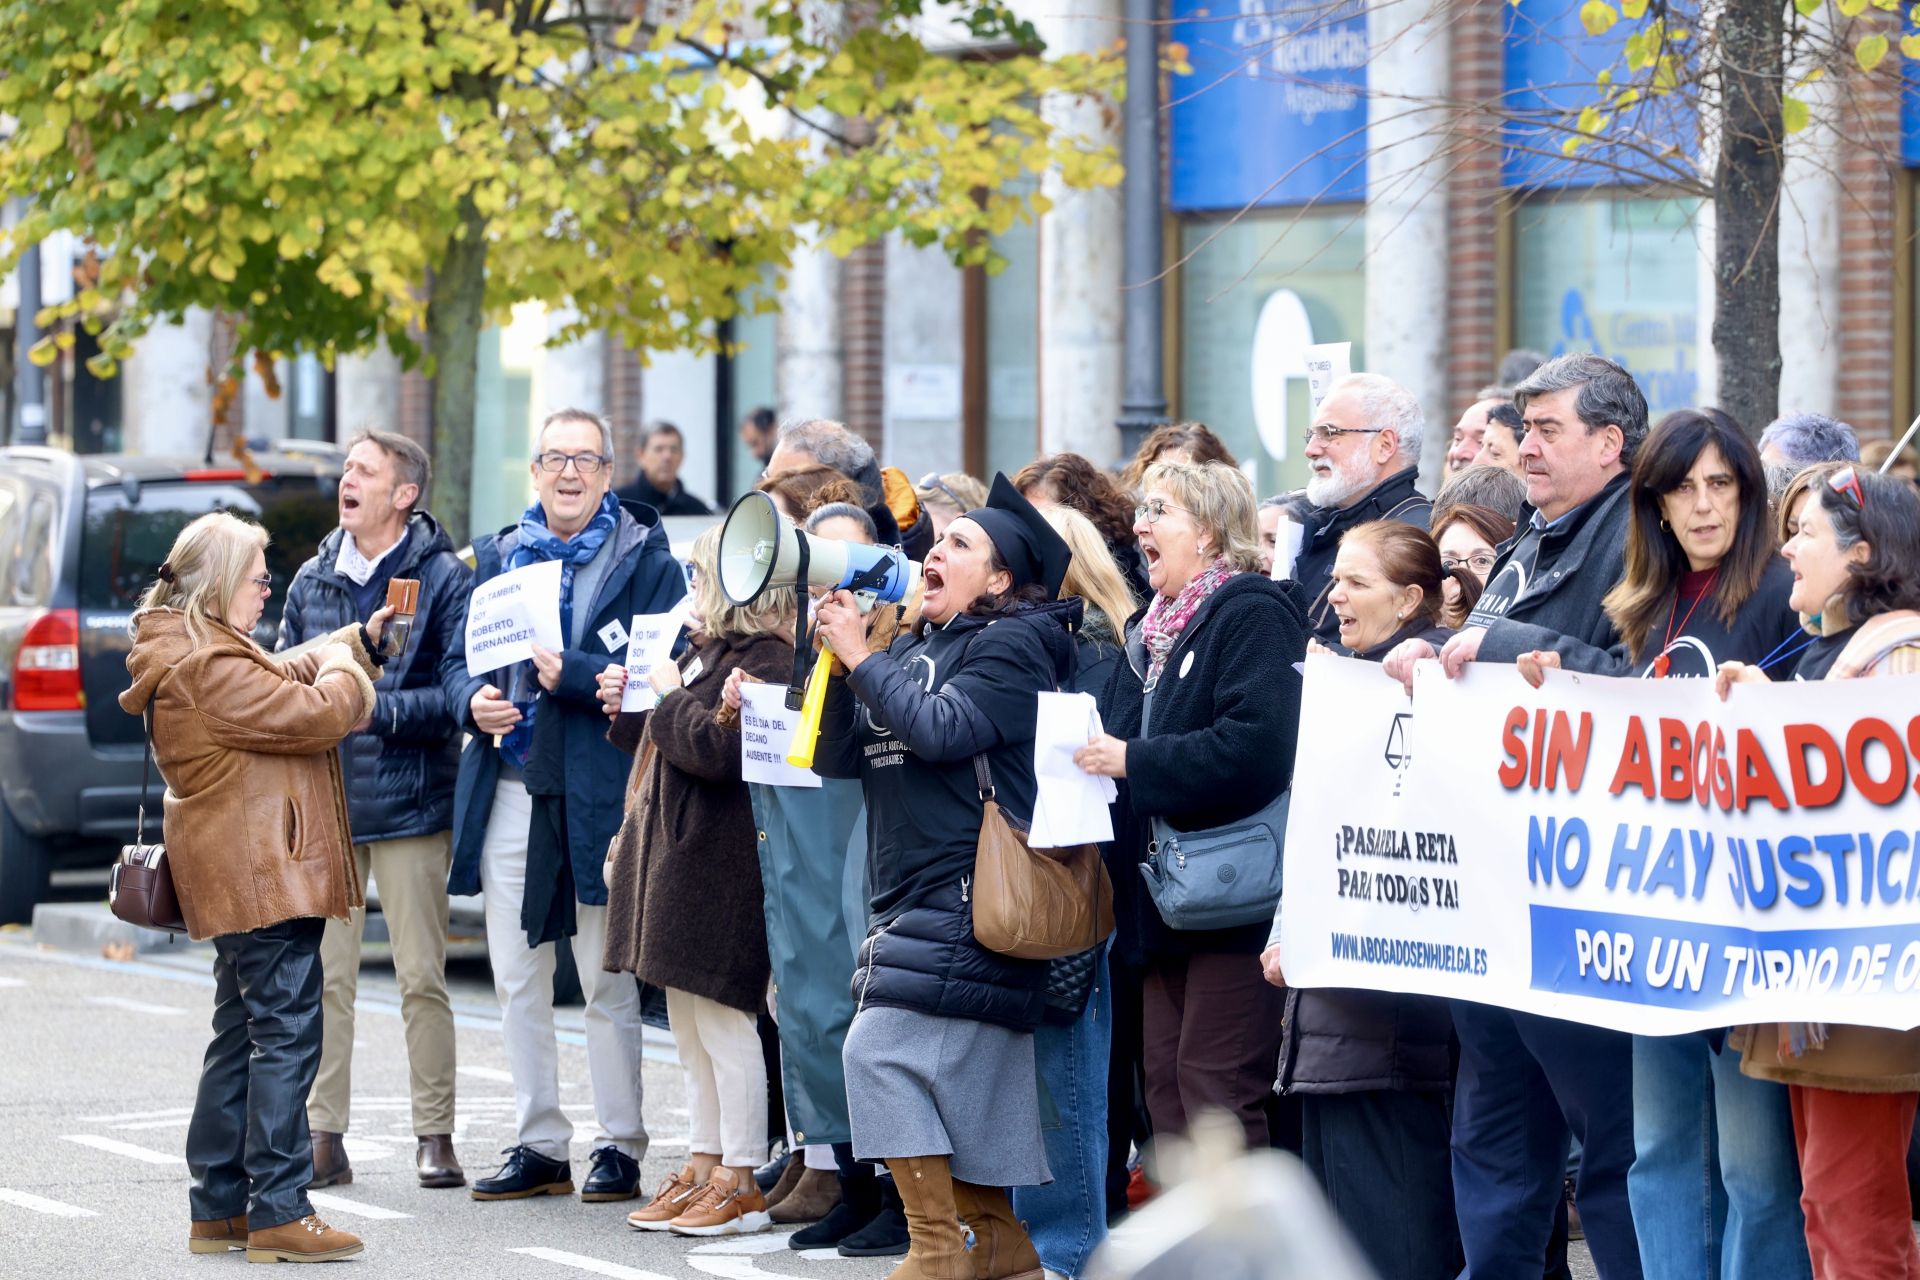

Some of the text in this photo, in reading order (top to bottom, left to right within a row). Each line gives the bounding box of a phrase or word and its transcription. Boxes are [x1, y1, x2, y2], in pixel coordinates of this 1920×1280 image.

[471, 618, 514, 638] ROBERTO
[635, 630, 643, 640] YO
[632, 648, 645, 658] SOY
[744, 715, 752, 726] ES
[752, 717, 759, 727] EL
[772, 720, 787, 731] DEL
[745, 731, 768, 745] DECANO
[1498, 706, 1592, 790] SIN
[746, 749, 772, 763] AUSENTE
[1336, 825, 1458, 864] ¡PASARELA RETA
[1527, 815, 1920, 909] NO HAY JUSTICI
[1337, 868, 1459, 912] PARA TOD@S YA!
[1331, 932, 1488, 976] WWW.ABOGADOSENHUELGA.ES
[1575, 928, 1920, 998] POR UN TURNO DE O
